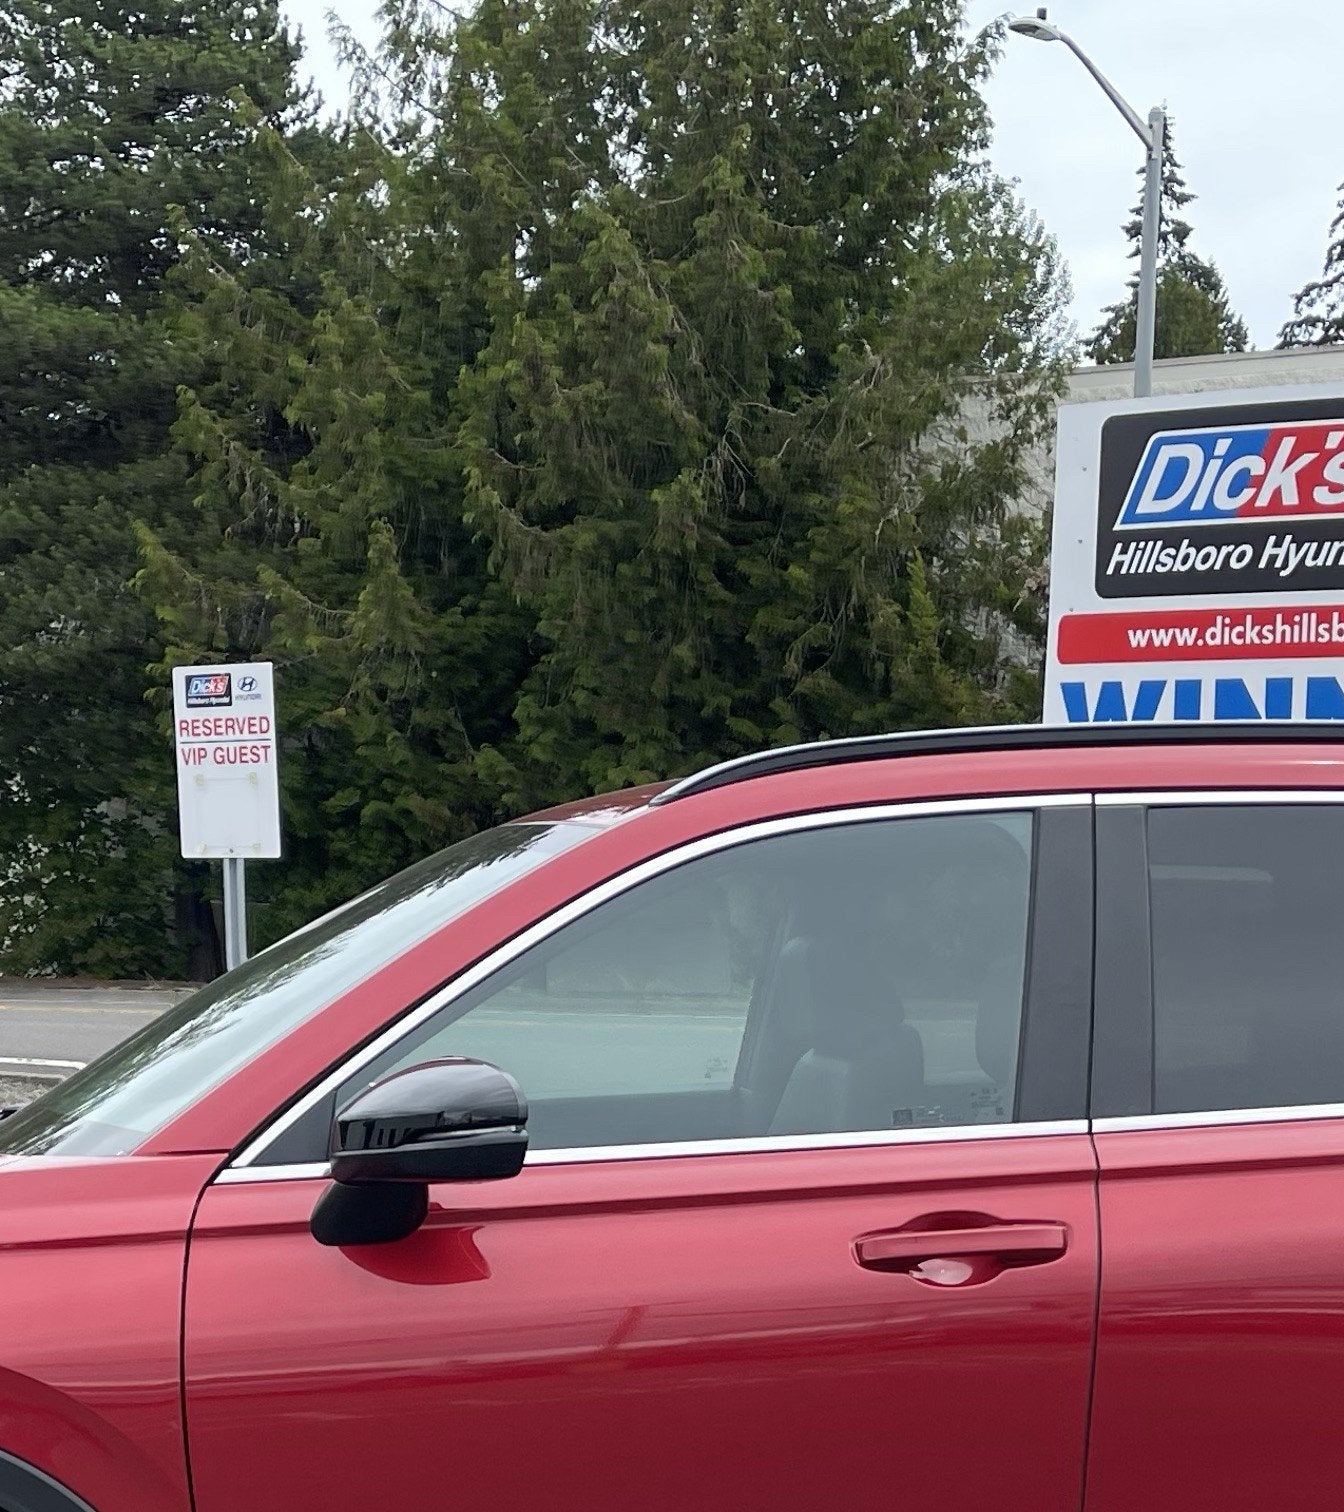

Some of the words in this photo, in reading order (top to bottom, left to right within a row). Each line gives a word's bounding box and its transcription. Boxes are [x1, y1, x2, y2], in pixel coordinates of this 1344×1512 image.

[1107, 540, 1253, 576] Hillsboro
[179, 715, 270, 737] RESERVED
[181, 747, 208, 765] VIP
[213, 744, 271, 765] GUEST
